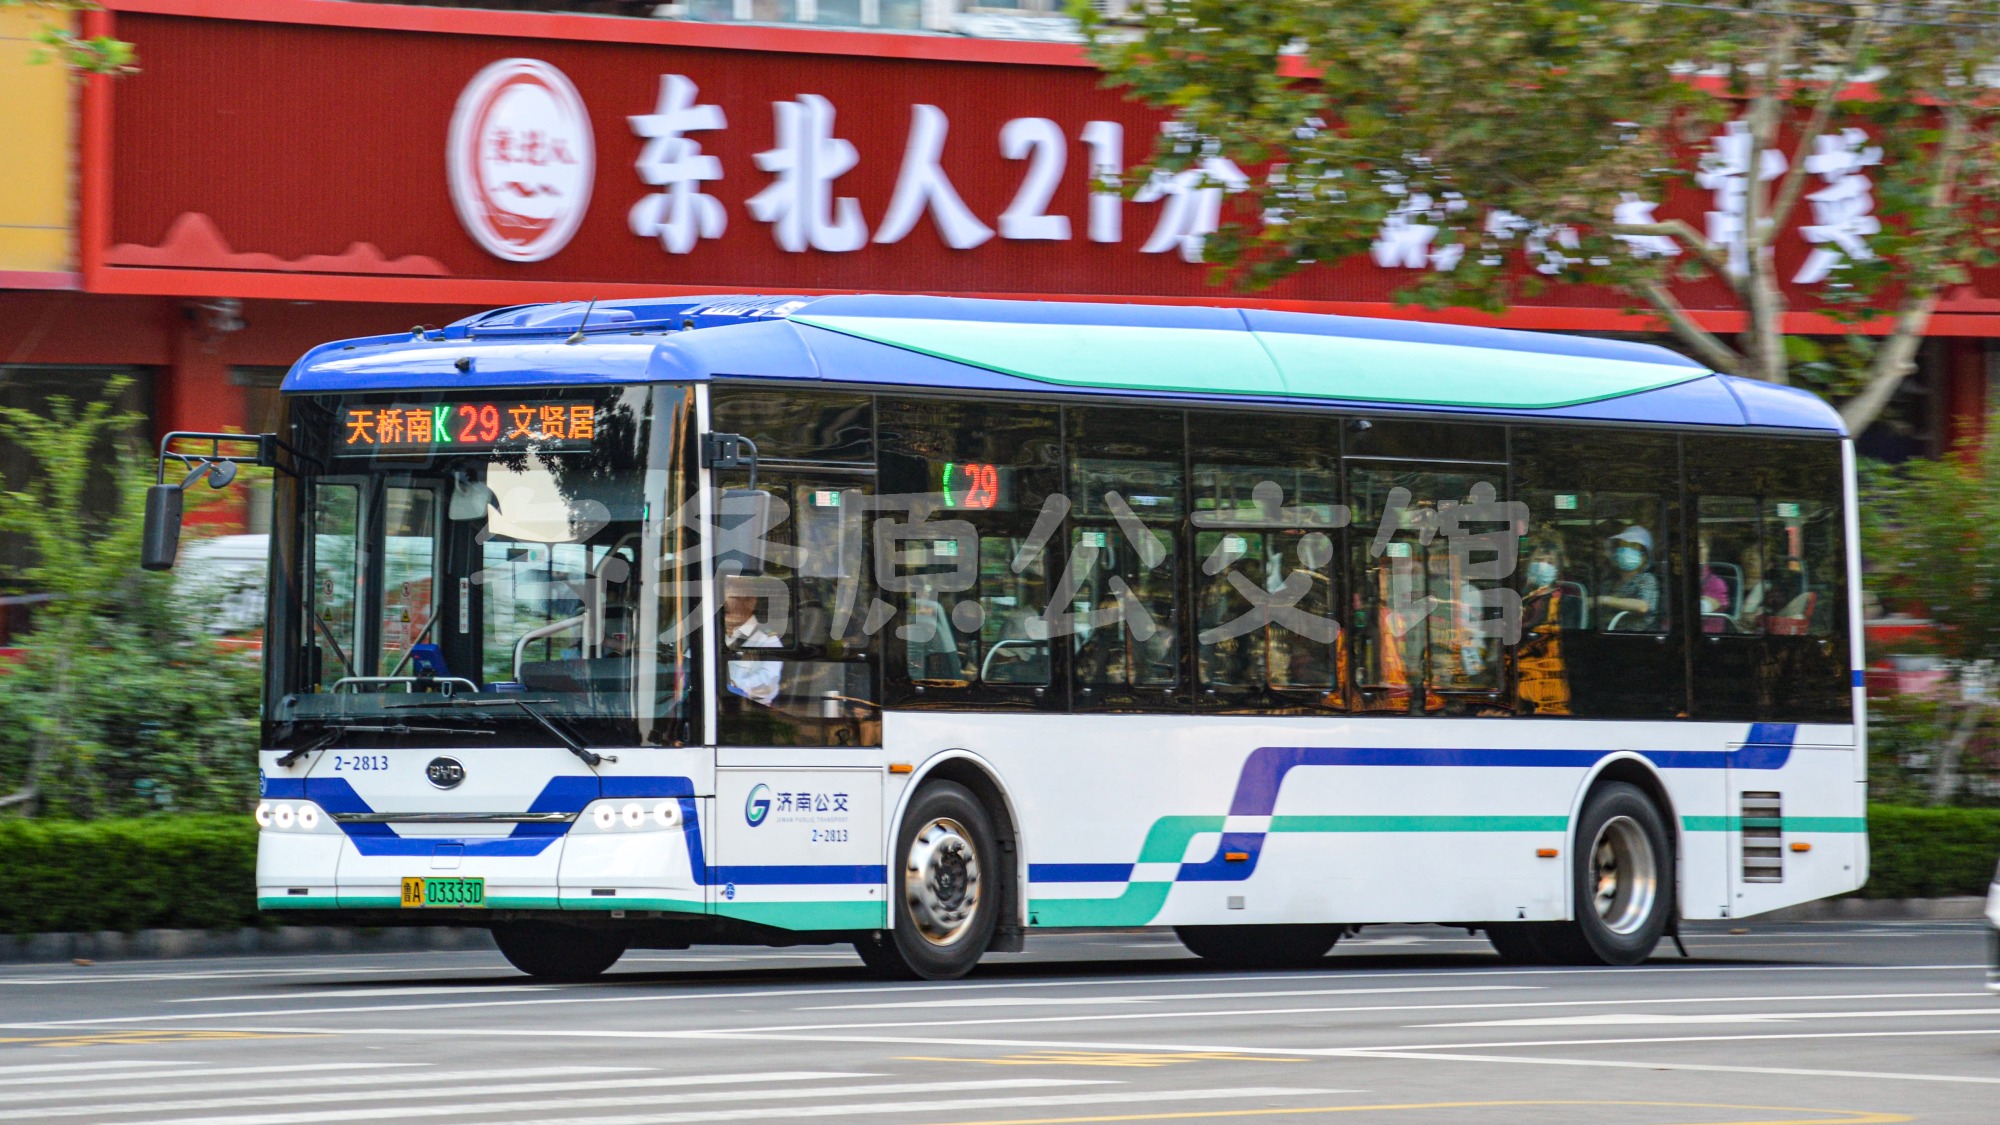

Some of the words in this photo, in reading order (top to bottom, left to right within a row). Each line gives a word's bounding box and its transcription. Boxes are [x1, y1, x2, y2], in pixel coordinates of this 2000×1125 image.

[346, 407, 432, 444] 天桥南
[459, 405, 500, 442] 29
[508, 404, 595, 440] 文贤居
[334, 756, 388, 771] 2-2813
[429, 765, 461, 780] BYD
[776, 792, 849, 812] 济南公交
[811, 829, 849, 842] 2-2813
